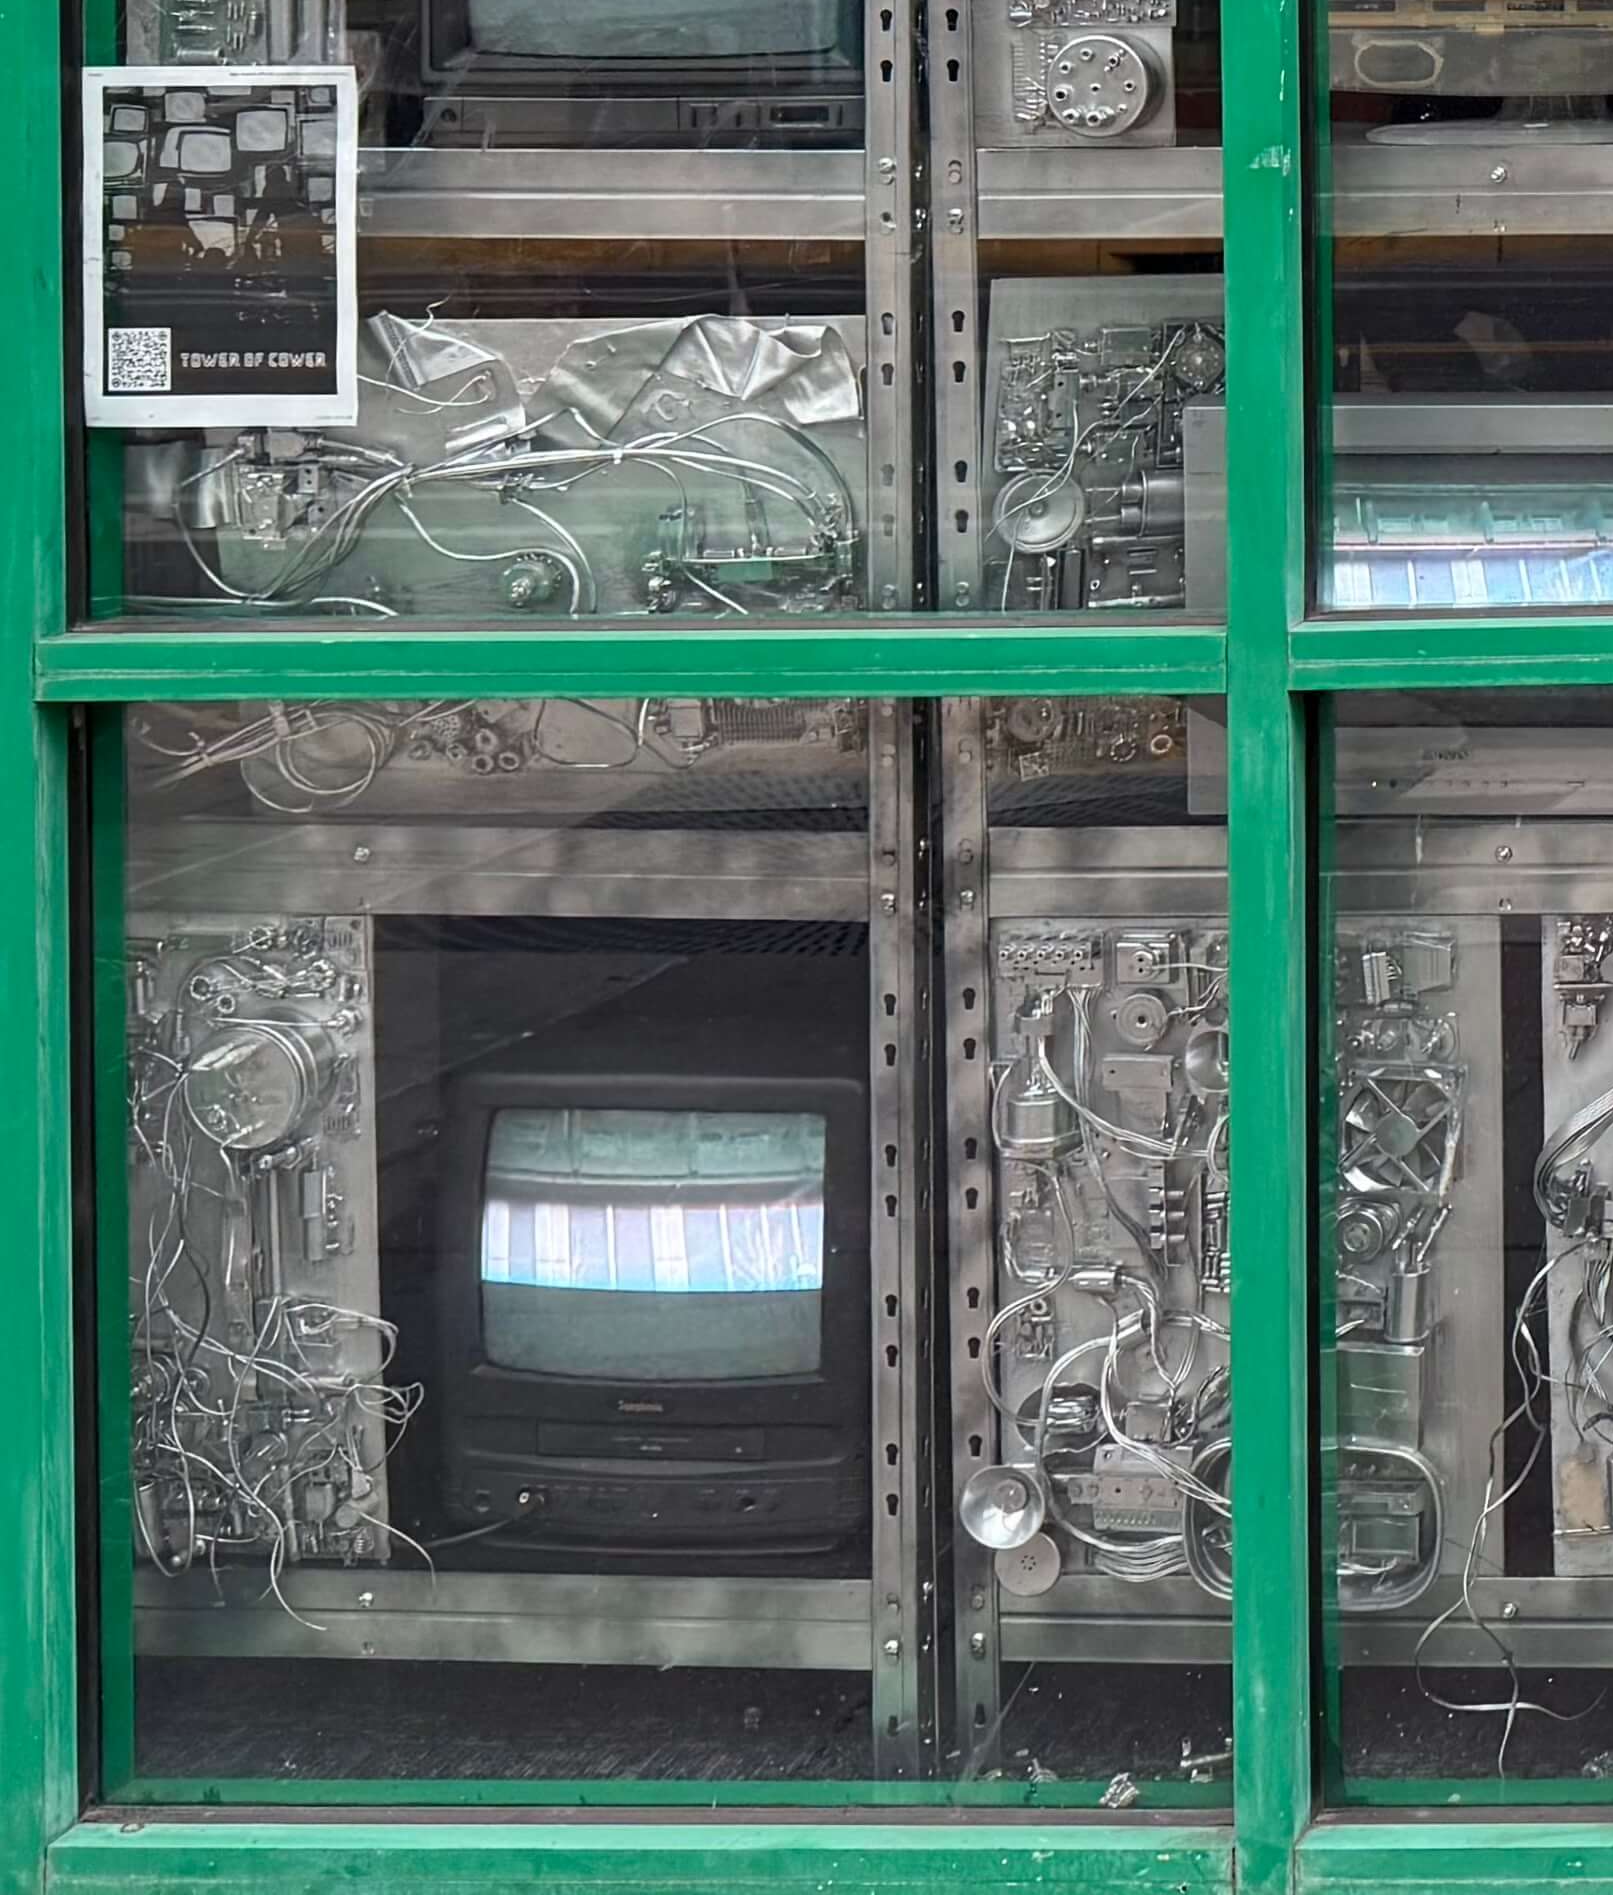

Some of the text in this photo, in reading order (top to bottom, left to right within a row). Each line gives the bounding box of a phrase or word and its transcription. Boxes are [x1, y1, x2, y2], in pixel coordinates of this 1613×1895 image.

[180, 352, 326, 368] TOWER OF COWER
